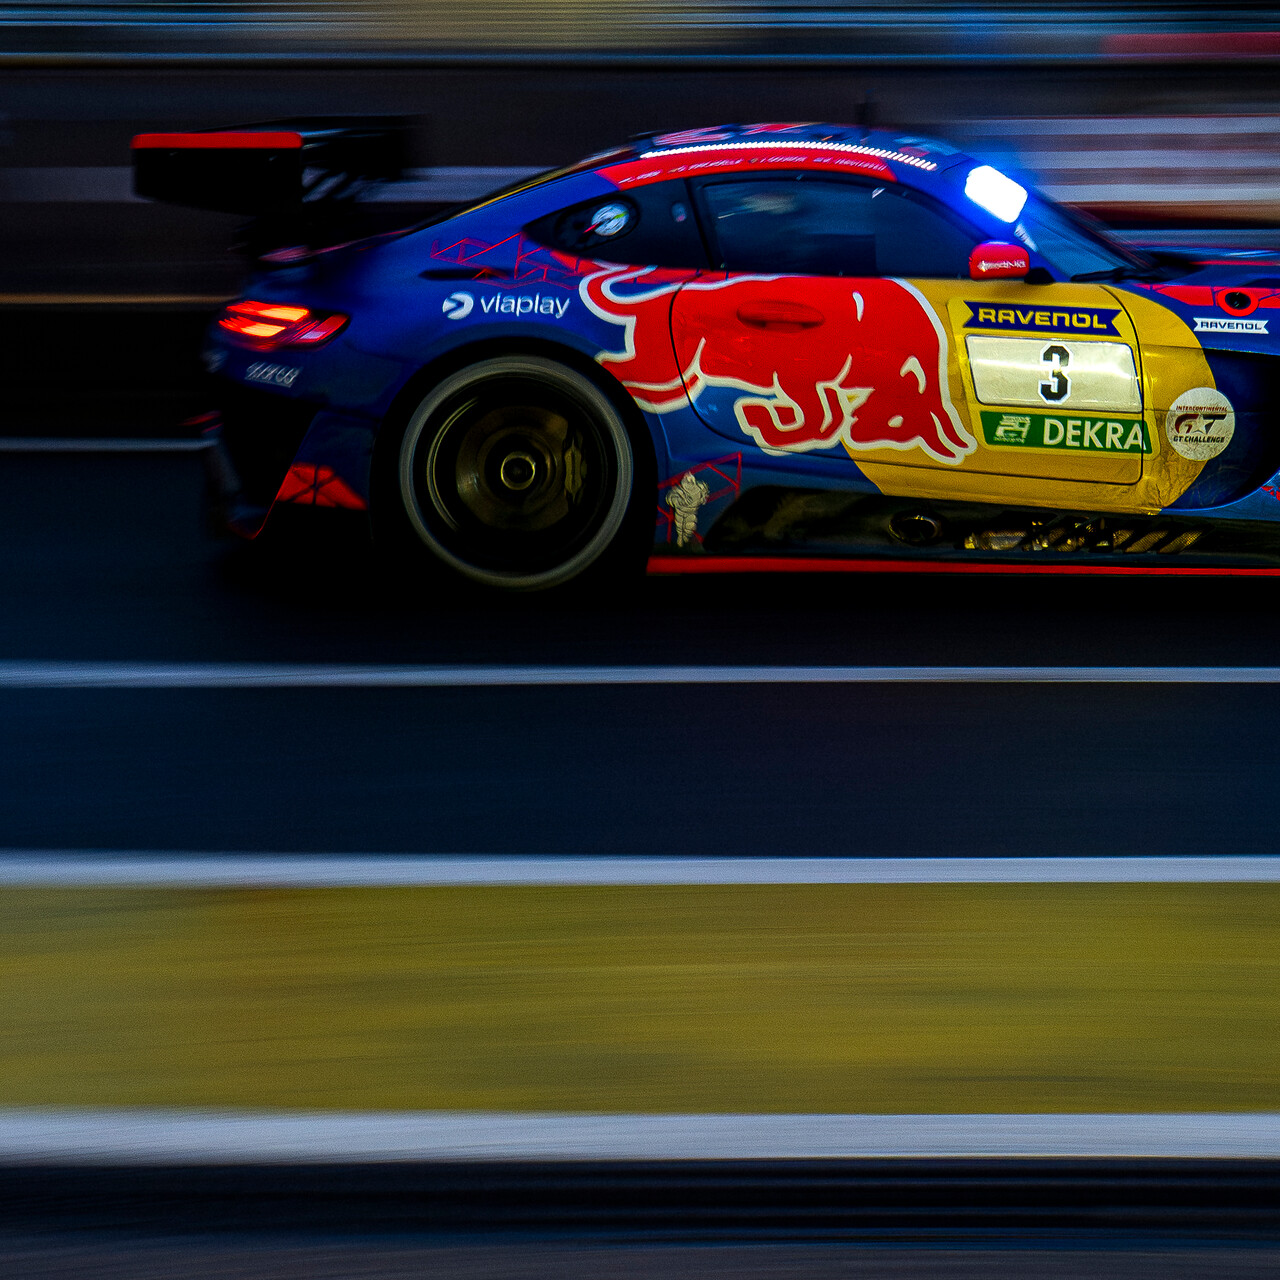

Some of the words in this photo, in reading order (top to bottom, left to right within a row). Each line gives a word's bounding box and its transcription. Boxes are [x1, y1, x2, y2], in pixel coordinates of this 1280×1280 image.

[480, 292, 570, 319] viaplay
[978, 307, 1108, 329] RAVENOL
[1200, 320, 1263, 331] RAVENOL
[1039, 343, 1072, 403] 3
[1043, 417, 1147, 451] DEKRA
[1184, 435, 1226, 443] CHALLENGE
